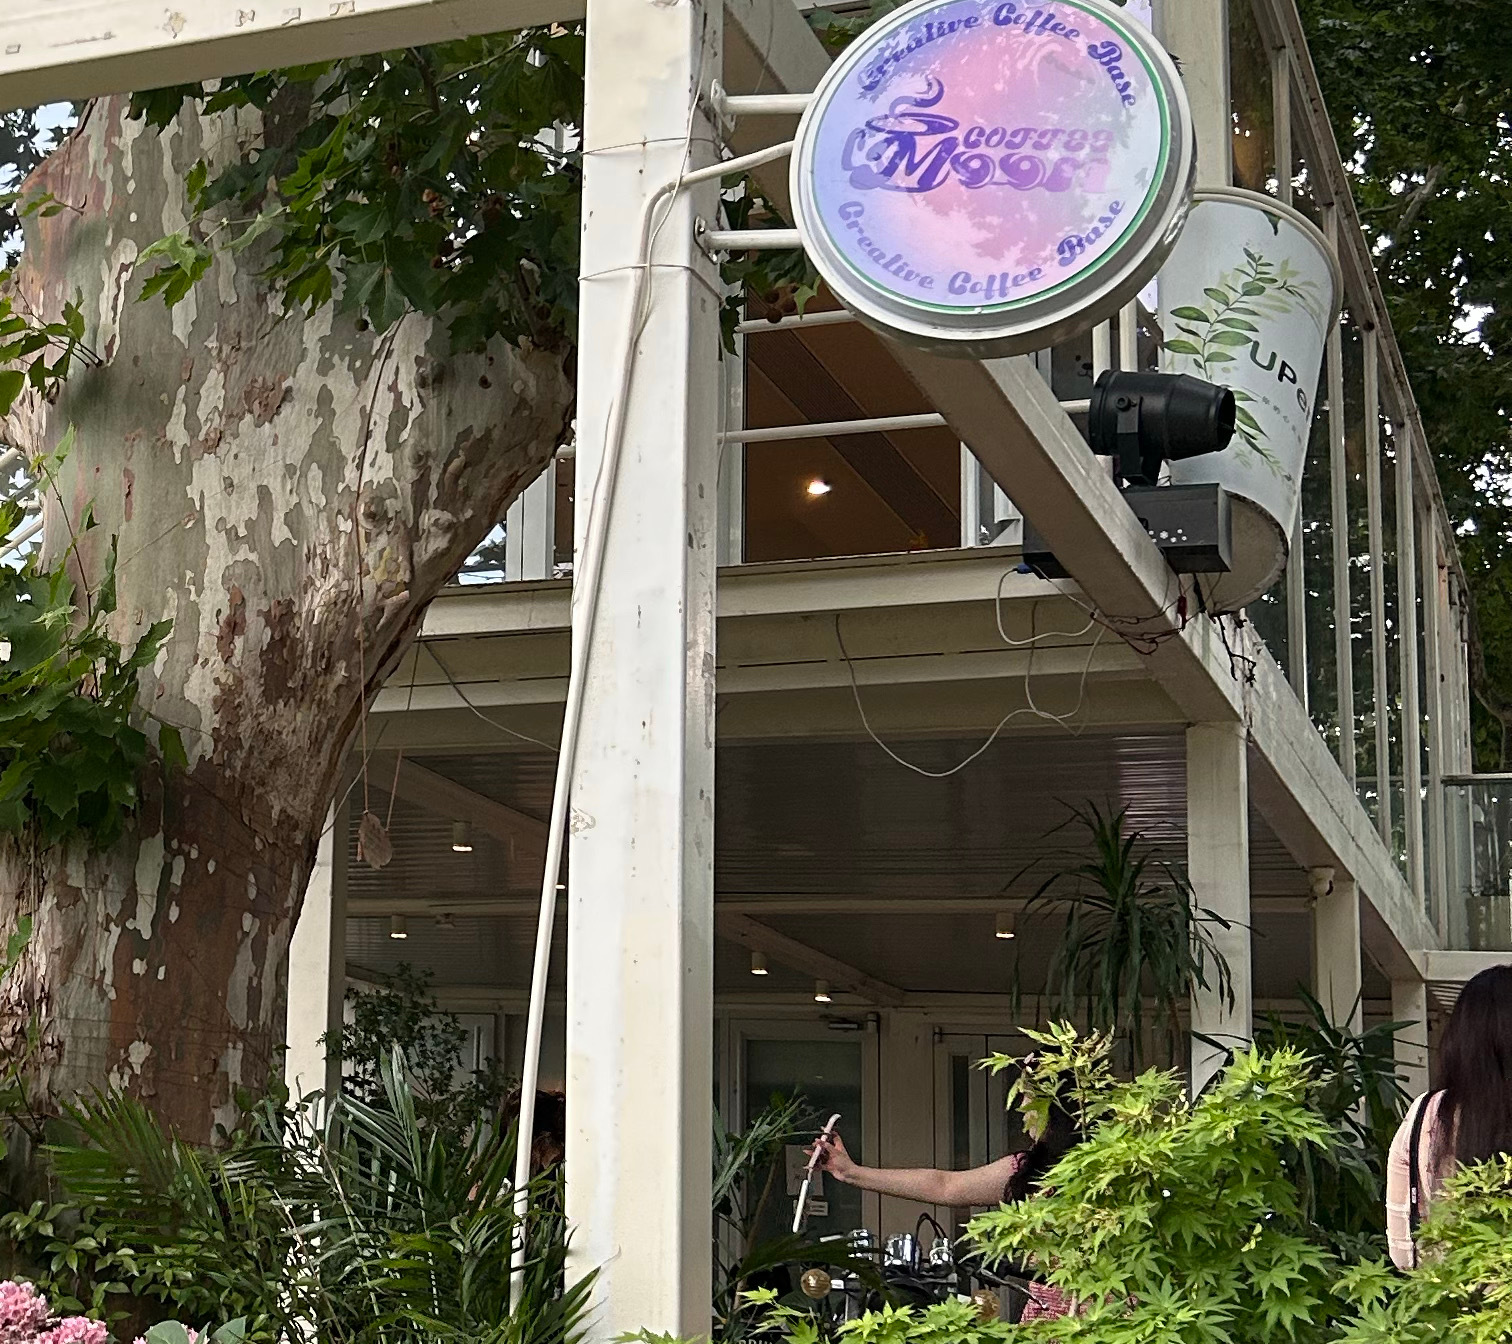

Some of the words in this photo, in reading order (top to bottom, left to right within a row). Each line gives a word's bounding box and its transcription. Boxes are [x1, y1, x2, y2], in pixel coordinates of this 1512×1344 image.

[993, 2, 1080, 43] Coffee
[1087, 40, 1136, 109] Base
[963, 125, 1114, 153] COFFEE
[837, 200, 934, 290] Creative
[948, 270, 1046, 301] Coffee
[1056, 199, 1127, 267] Base
